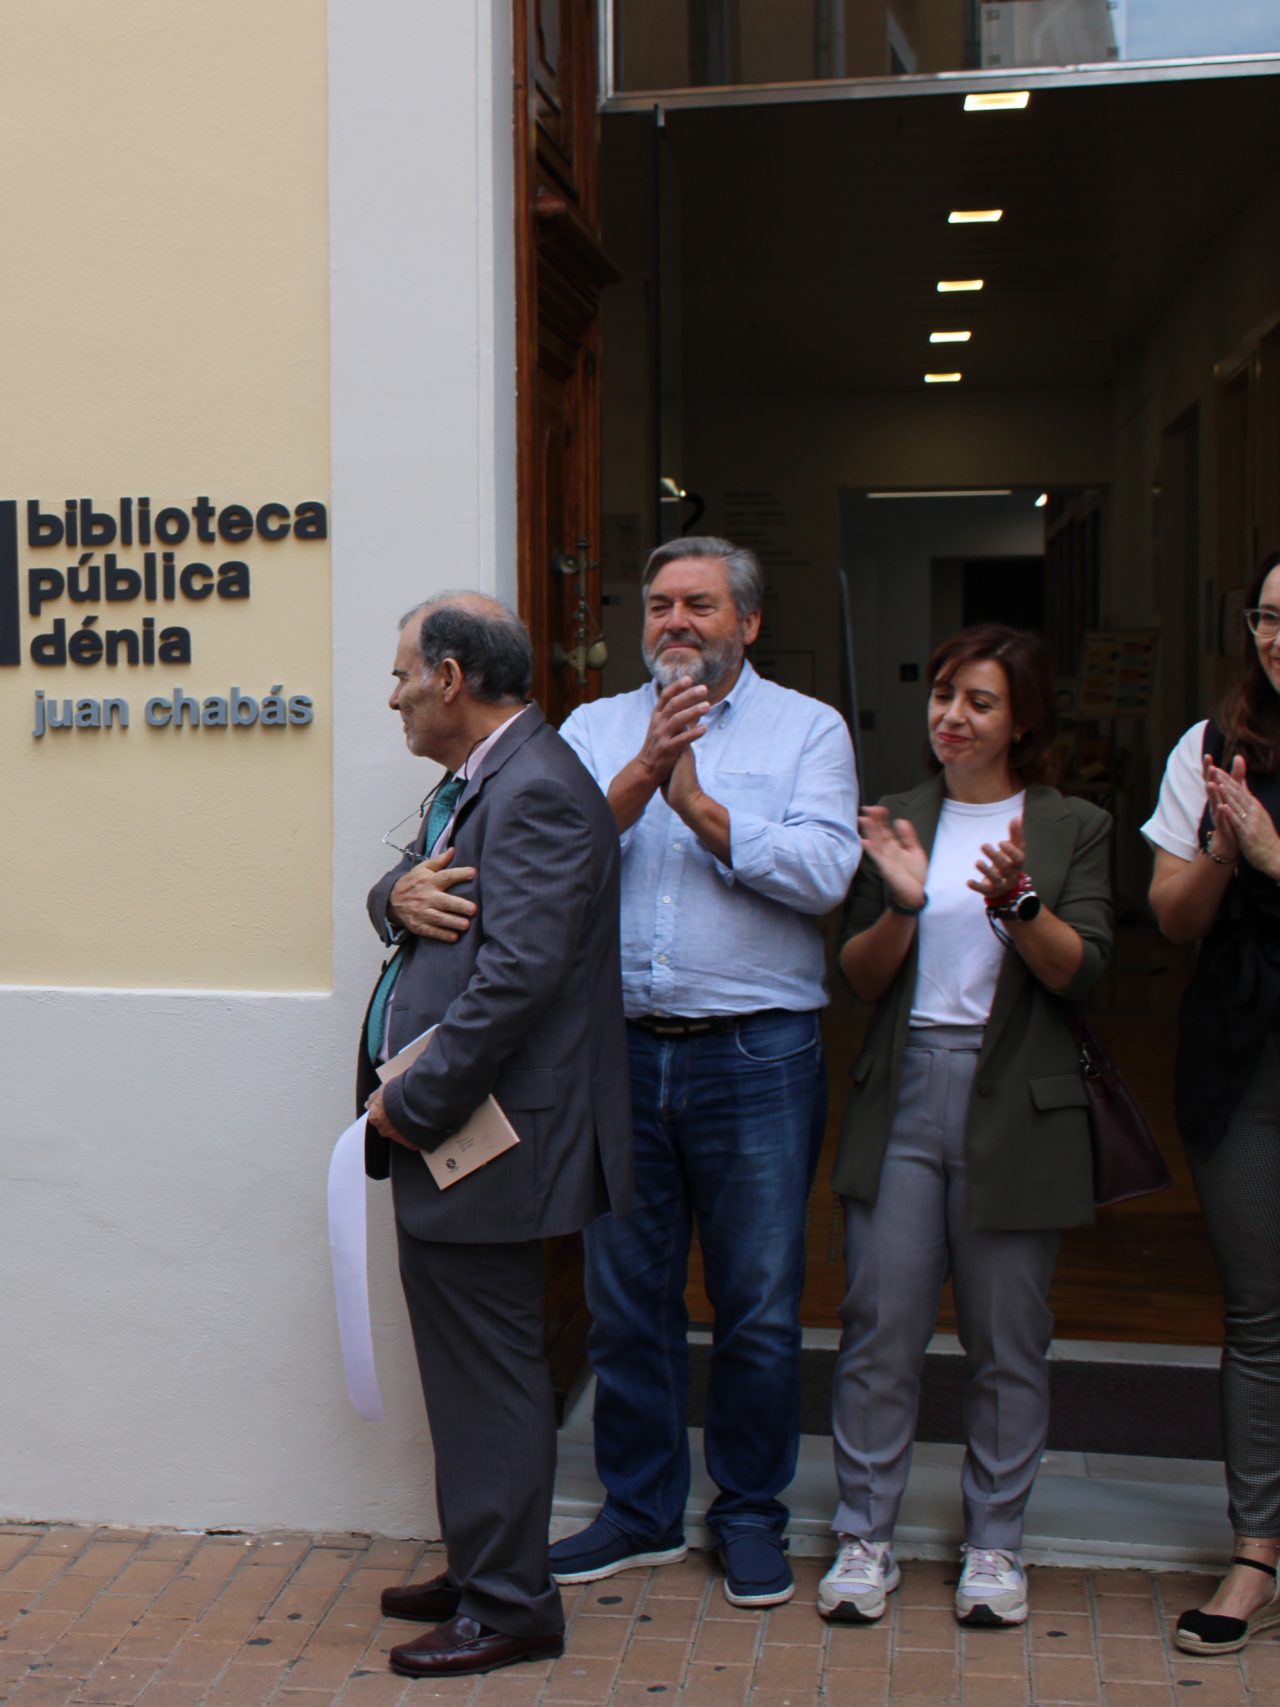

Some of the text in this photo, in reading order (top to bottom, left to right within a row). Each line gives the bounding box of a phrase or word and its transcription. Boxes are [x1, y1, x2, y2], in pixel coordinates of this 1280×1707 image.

[27, 496, 328, 547] biblioteca
[28, 552, 251, 616] pública
[30, 615, 192, 666] dénia
[32, 685, 315, 737] juan chabás
